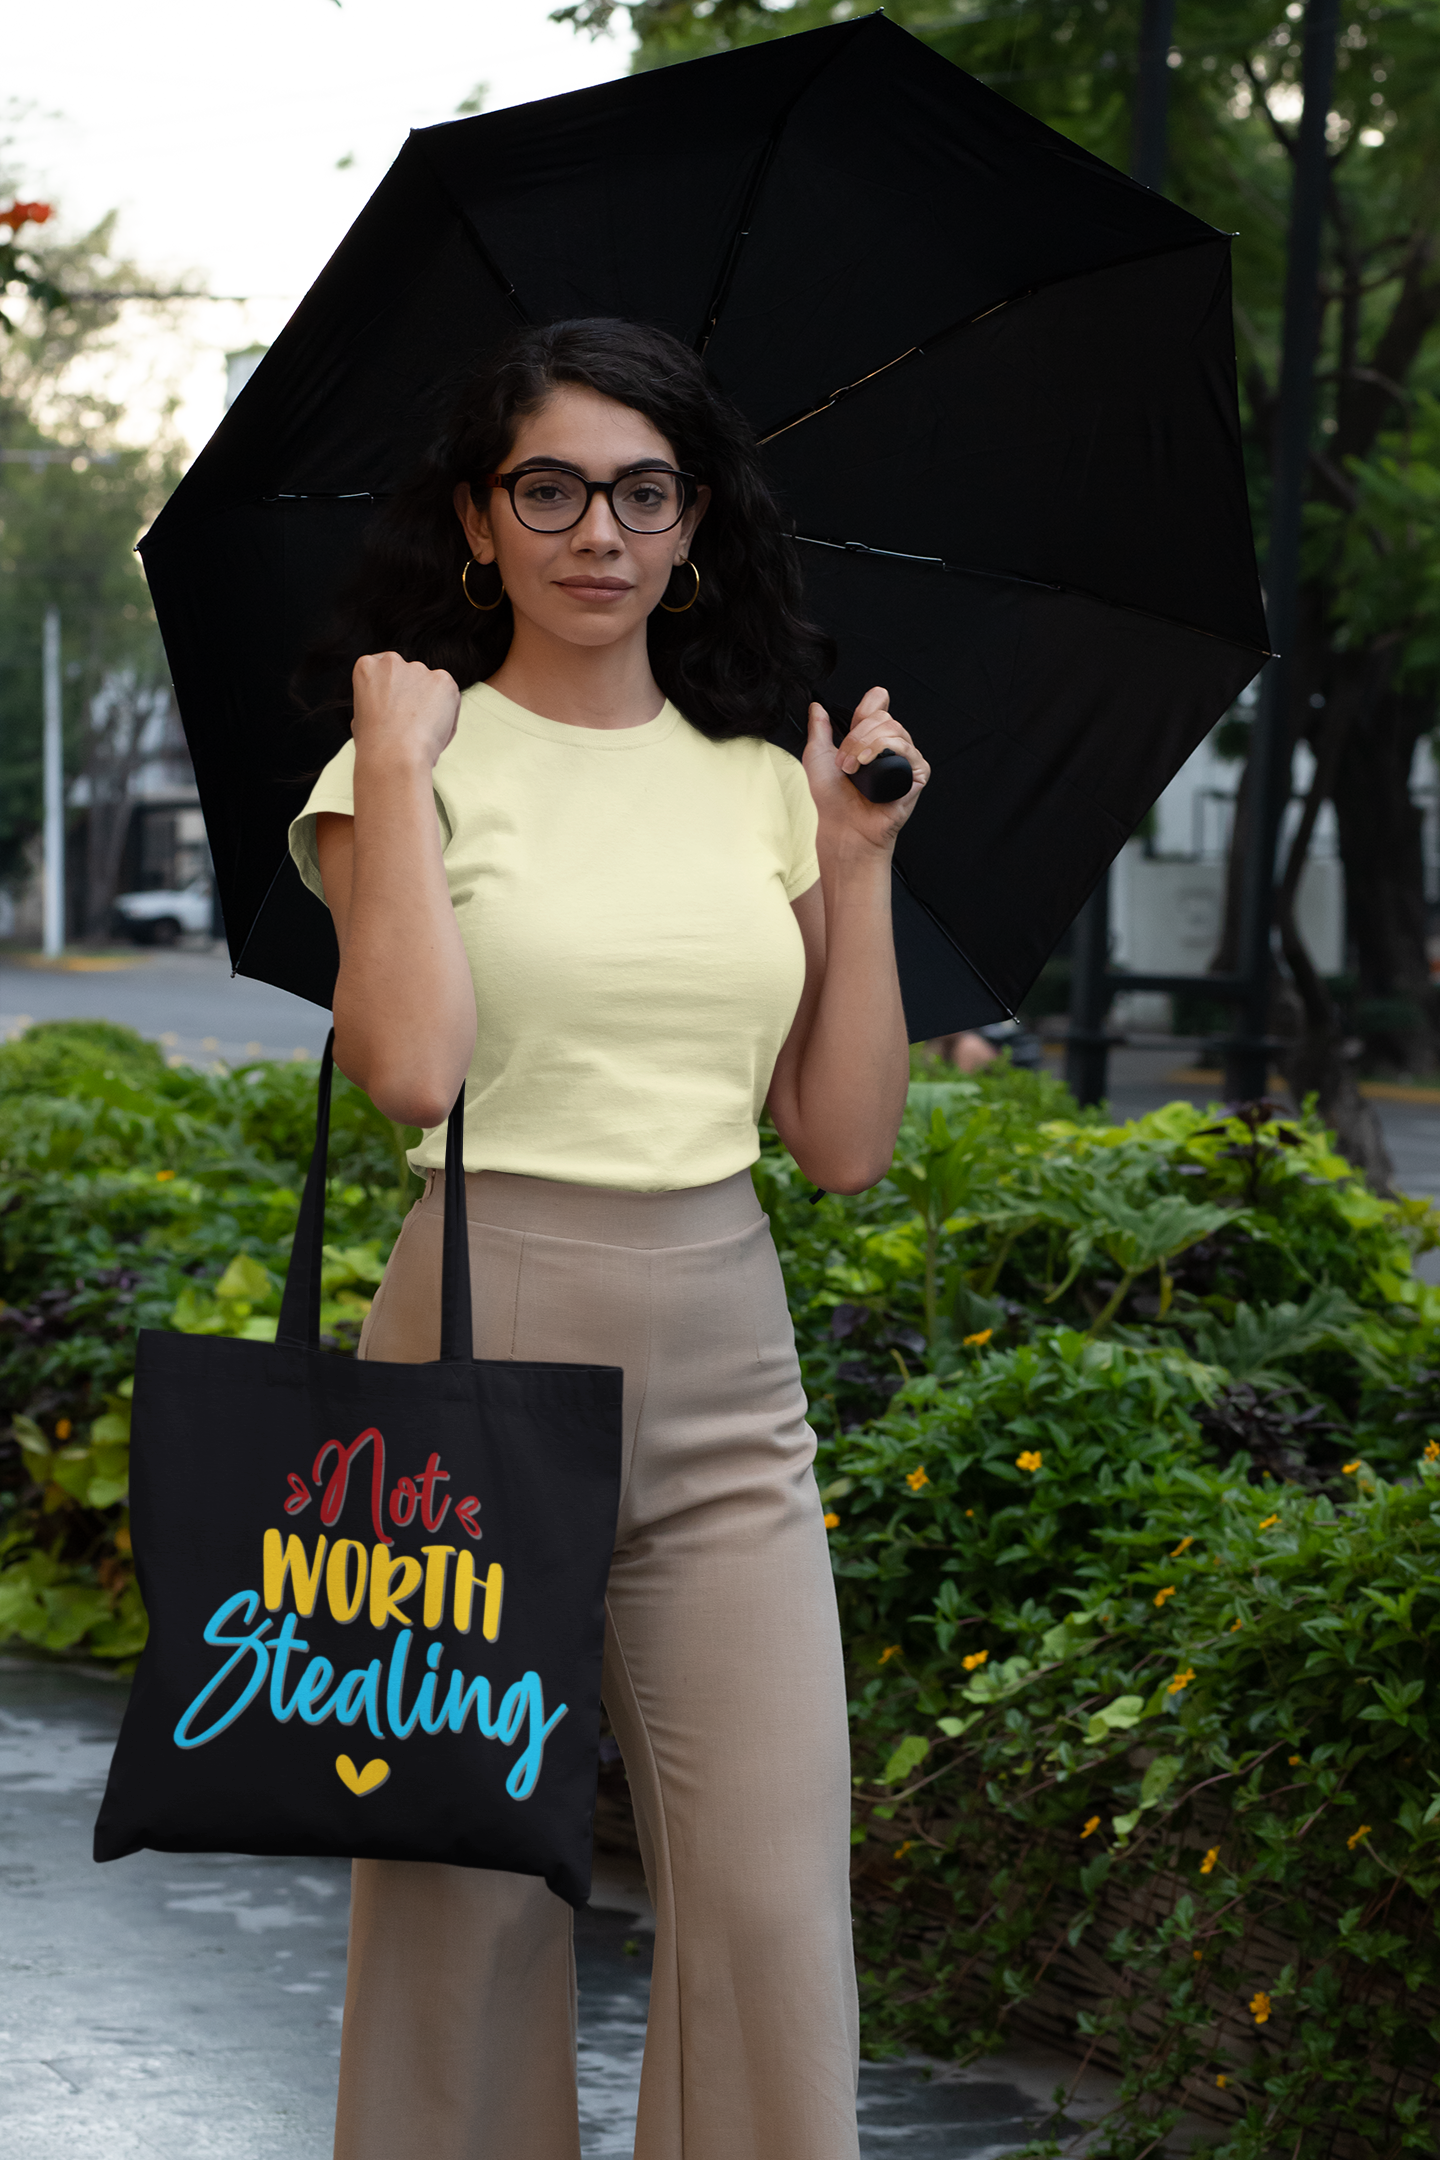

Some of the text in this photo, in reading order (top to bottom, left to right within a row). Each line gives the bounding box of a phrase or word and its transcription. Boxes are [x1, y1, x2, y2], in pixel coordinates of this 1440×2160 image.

[312, 1427, 451, 1545] Not
[263, 1528, 504, 1642] WORTH
[173, 1589, 569, 1801] Stealing
